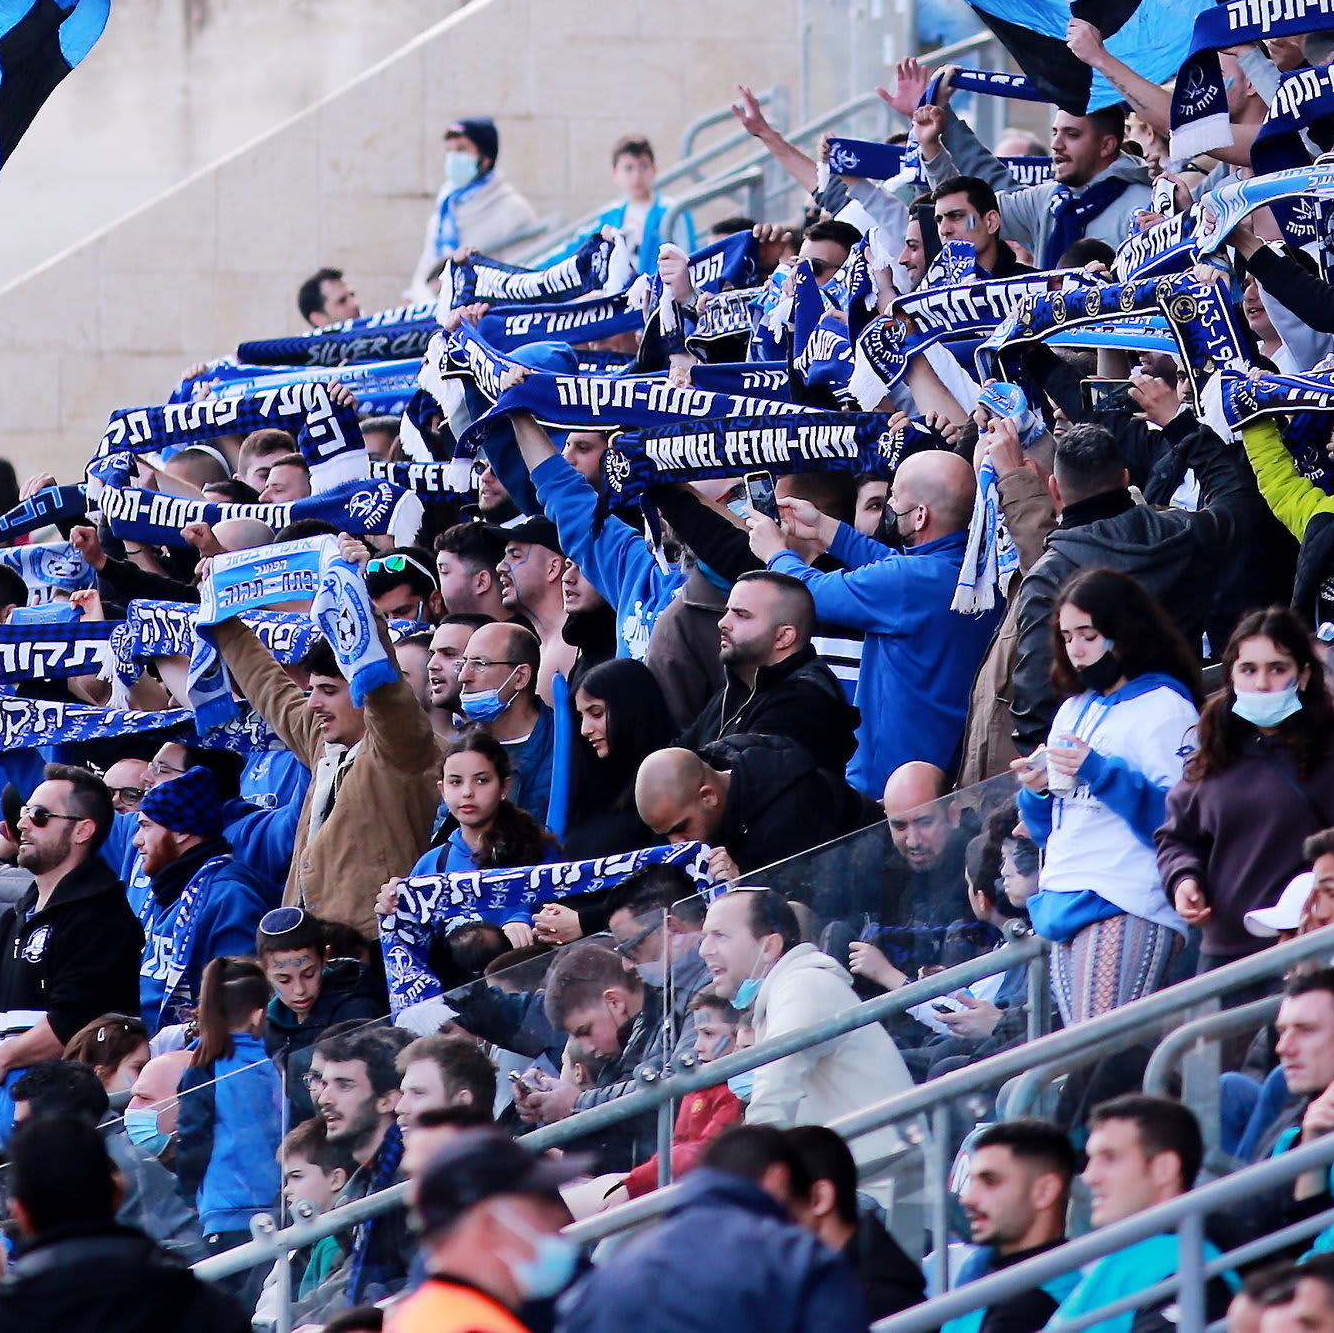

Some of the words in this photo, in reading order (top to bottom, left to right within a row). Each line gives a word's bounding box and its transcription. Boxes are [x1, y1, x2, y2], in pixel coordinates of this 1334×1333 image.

[1007, 159, 1055, 185] פועל
[304, 336, 390, 366] SILVER
[390, 329, 433, 356] CLU
[555, 376, 717, 417] פתח-תקוה
[741, 370, 789, 390] קוה
[162, 395, 245, 434] פתח
[645, 432, 721, 472] HAPOEL
[725, 425, 859, 467] PETAH-TIKVA
[281, 569, 315, 594] פתח
